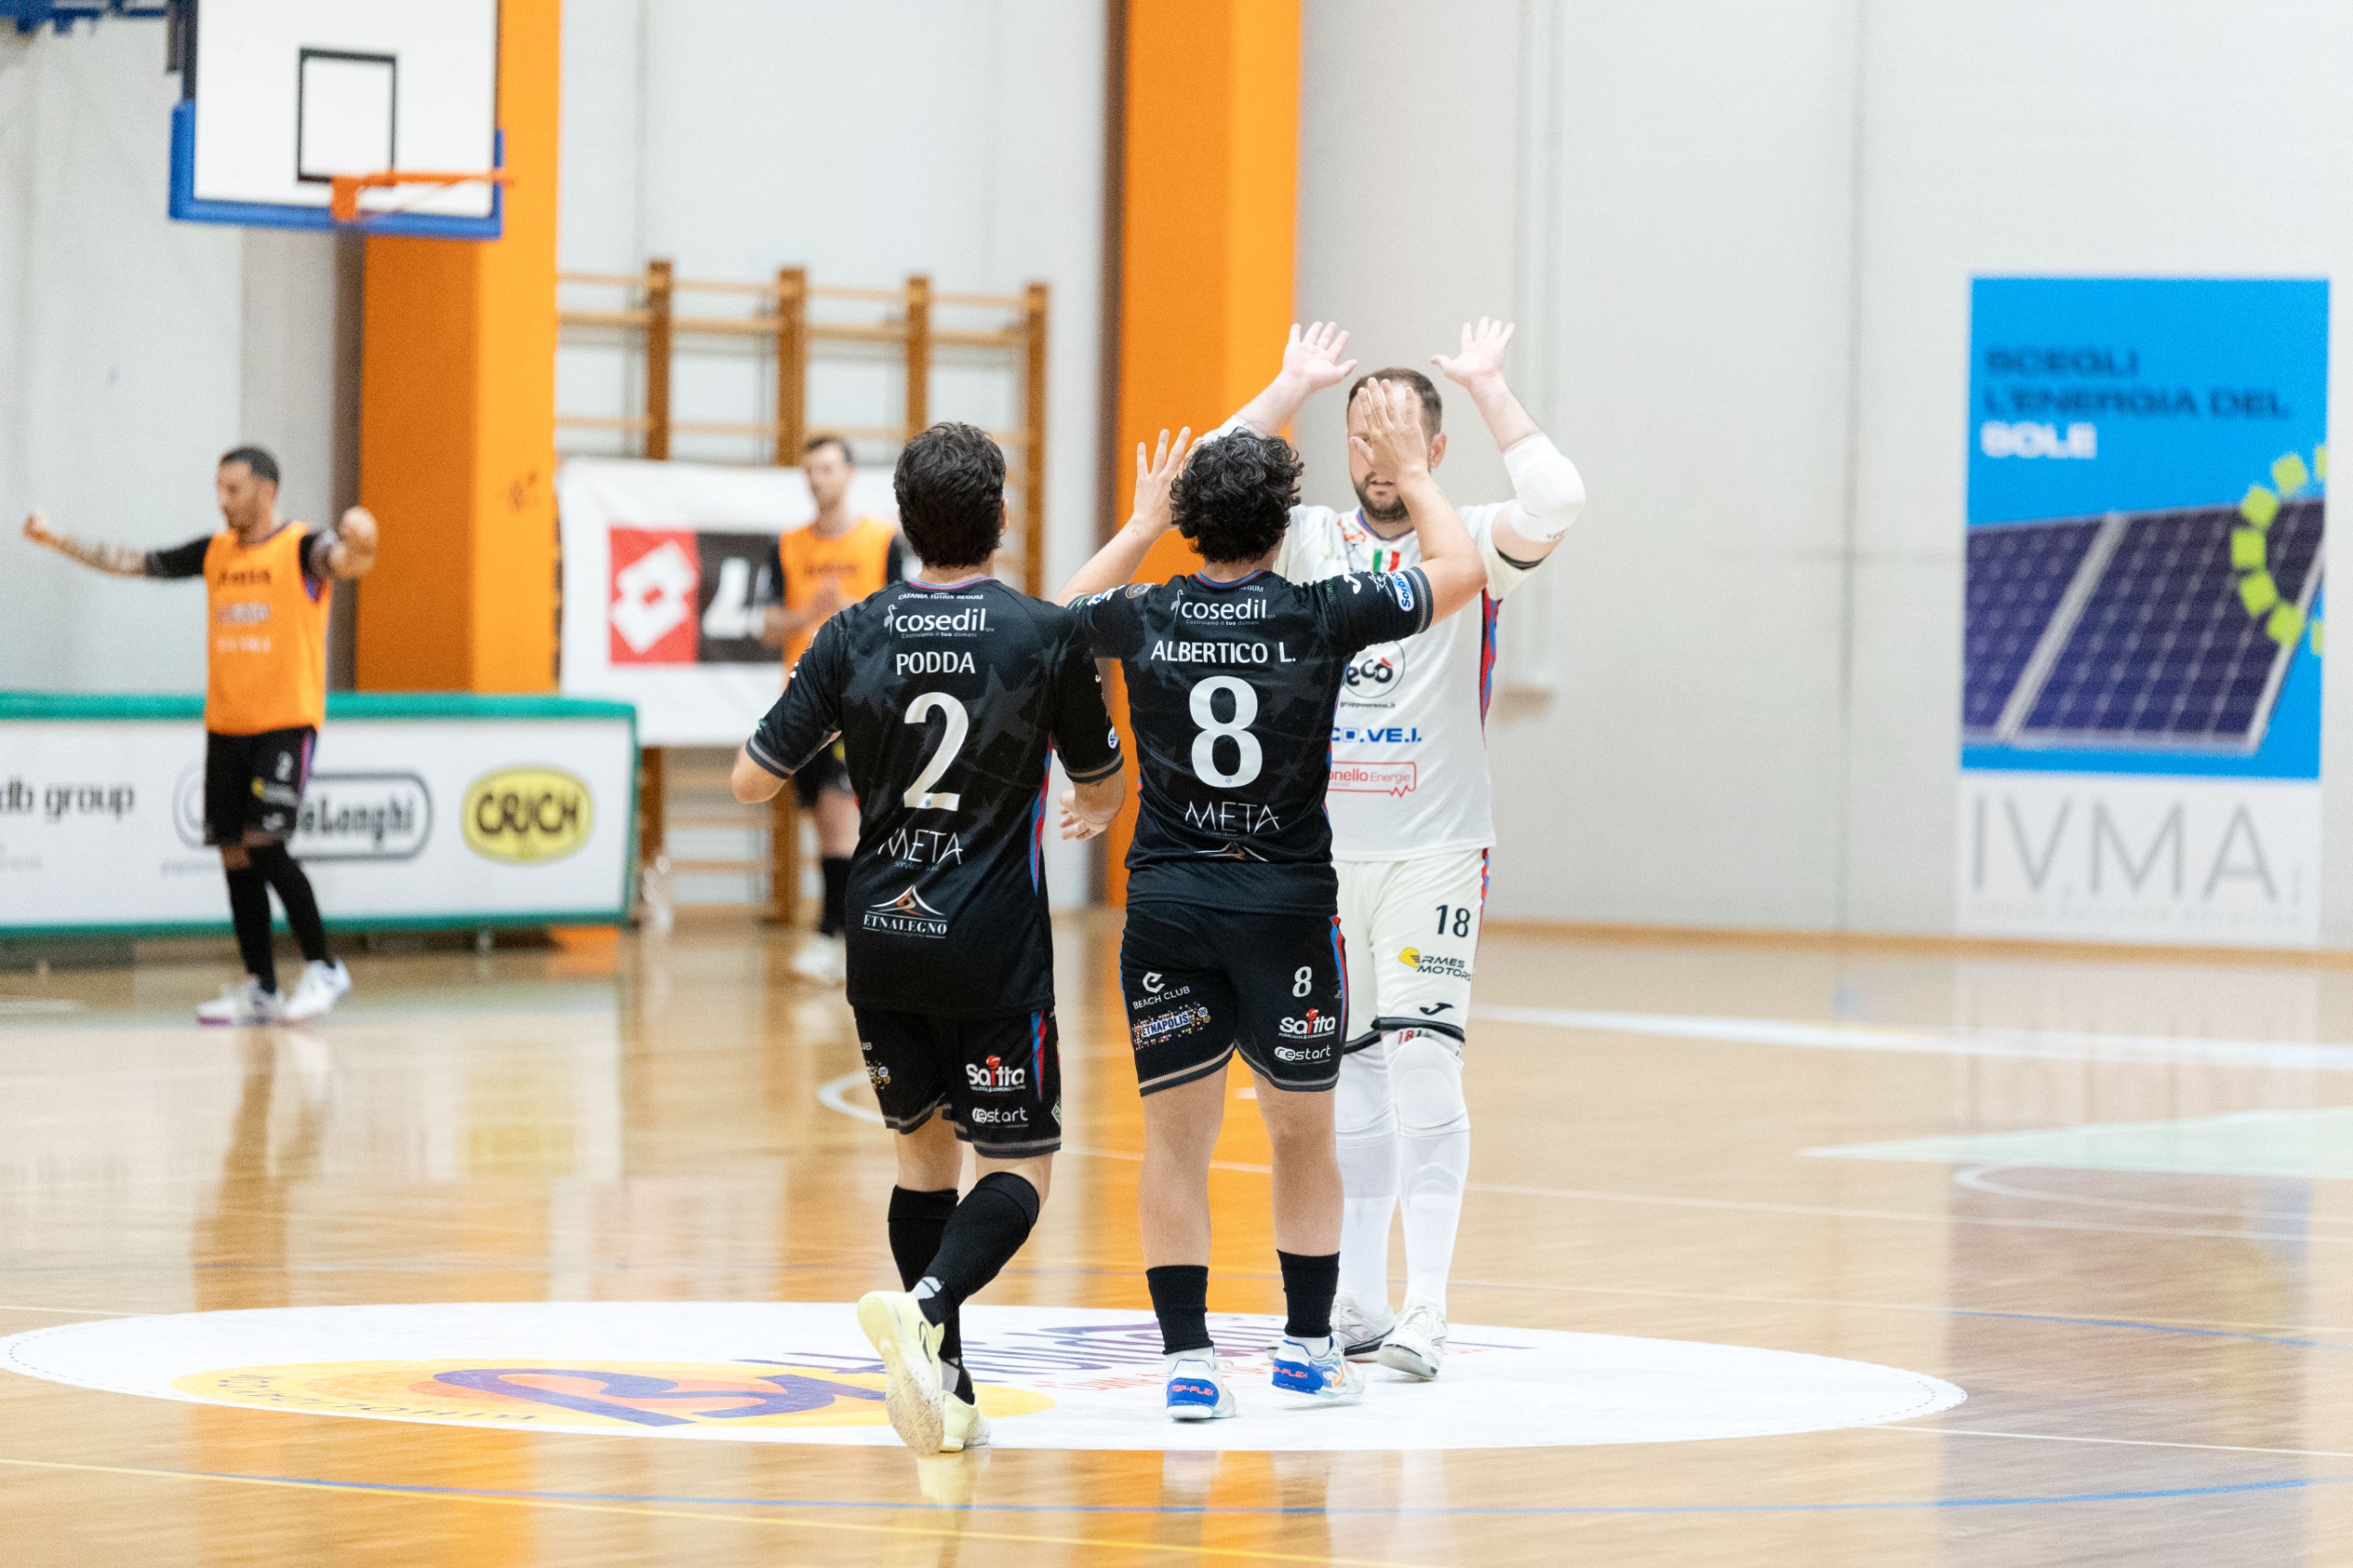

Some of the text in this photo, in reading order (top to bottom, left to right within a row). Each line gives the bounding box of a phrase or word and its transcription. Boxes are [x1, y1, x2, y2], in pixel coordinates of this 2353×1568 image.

[2210, 390, 2293, 418] DEL
[1980, 420, 2097, 459] SOLE
[895, 608, 986, 632] cosedil
[1181, 598, 1267, 619] cosedil
[896, 651, 976, 676] PODDA
[1150, 640, 1296, 664] ALBERTICO L.
[1189, 676, 1263, 788] 8
[904, 691, 970, 812] 2
[1370, 771, 1412, 785] Energie
[45, 787, 134, 824] group
[301, 794, 415, 845] eLonghi
[475, 792, 581, 835] CRICH
[1185, 801, 1279, 834] META
[877, 827, 963, 865] META
[863, 914, 948, 935] ETNALEGNO
[1436, 904, 1471, 937] 18
[1292, 966, 1313, 998] 8
[1132, 985, 1190, 1009] BEACH CLUB
[1142, 1013, 1189, 1037] ETNAPOLIS
[1274, 1045, 1331, 1061] restart
[972, 1107, 1029, 1123] restart
